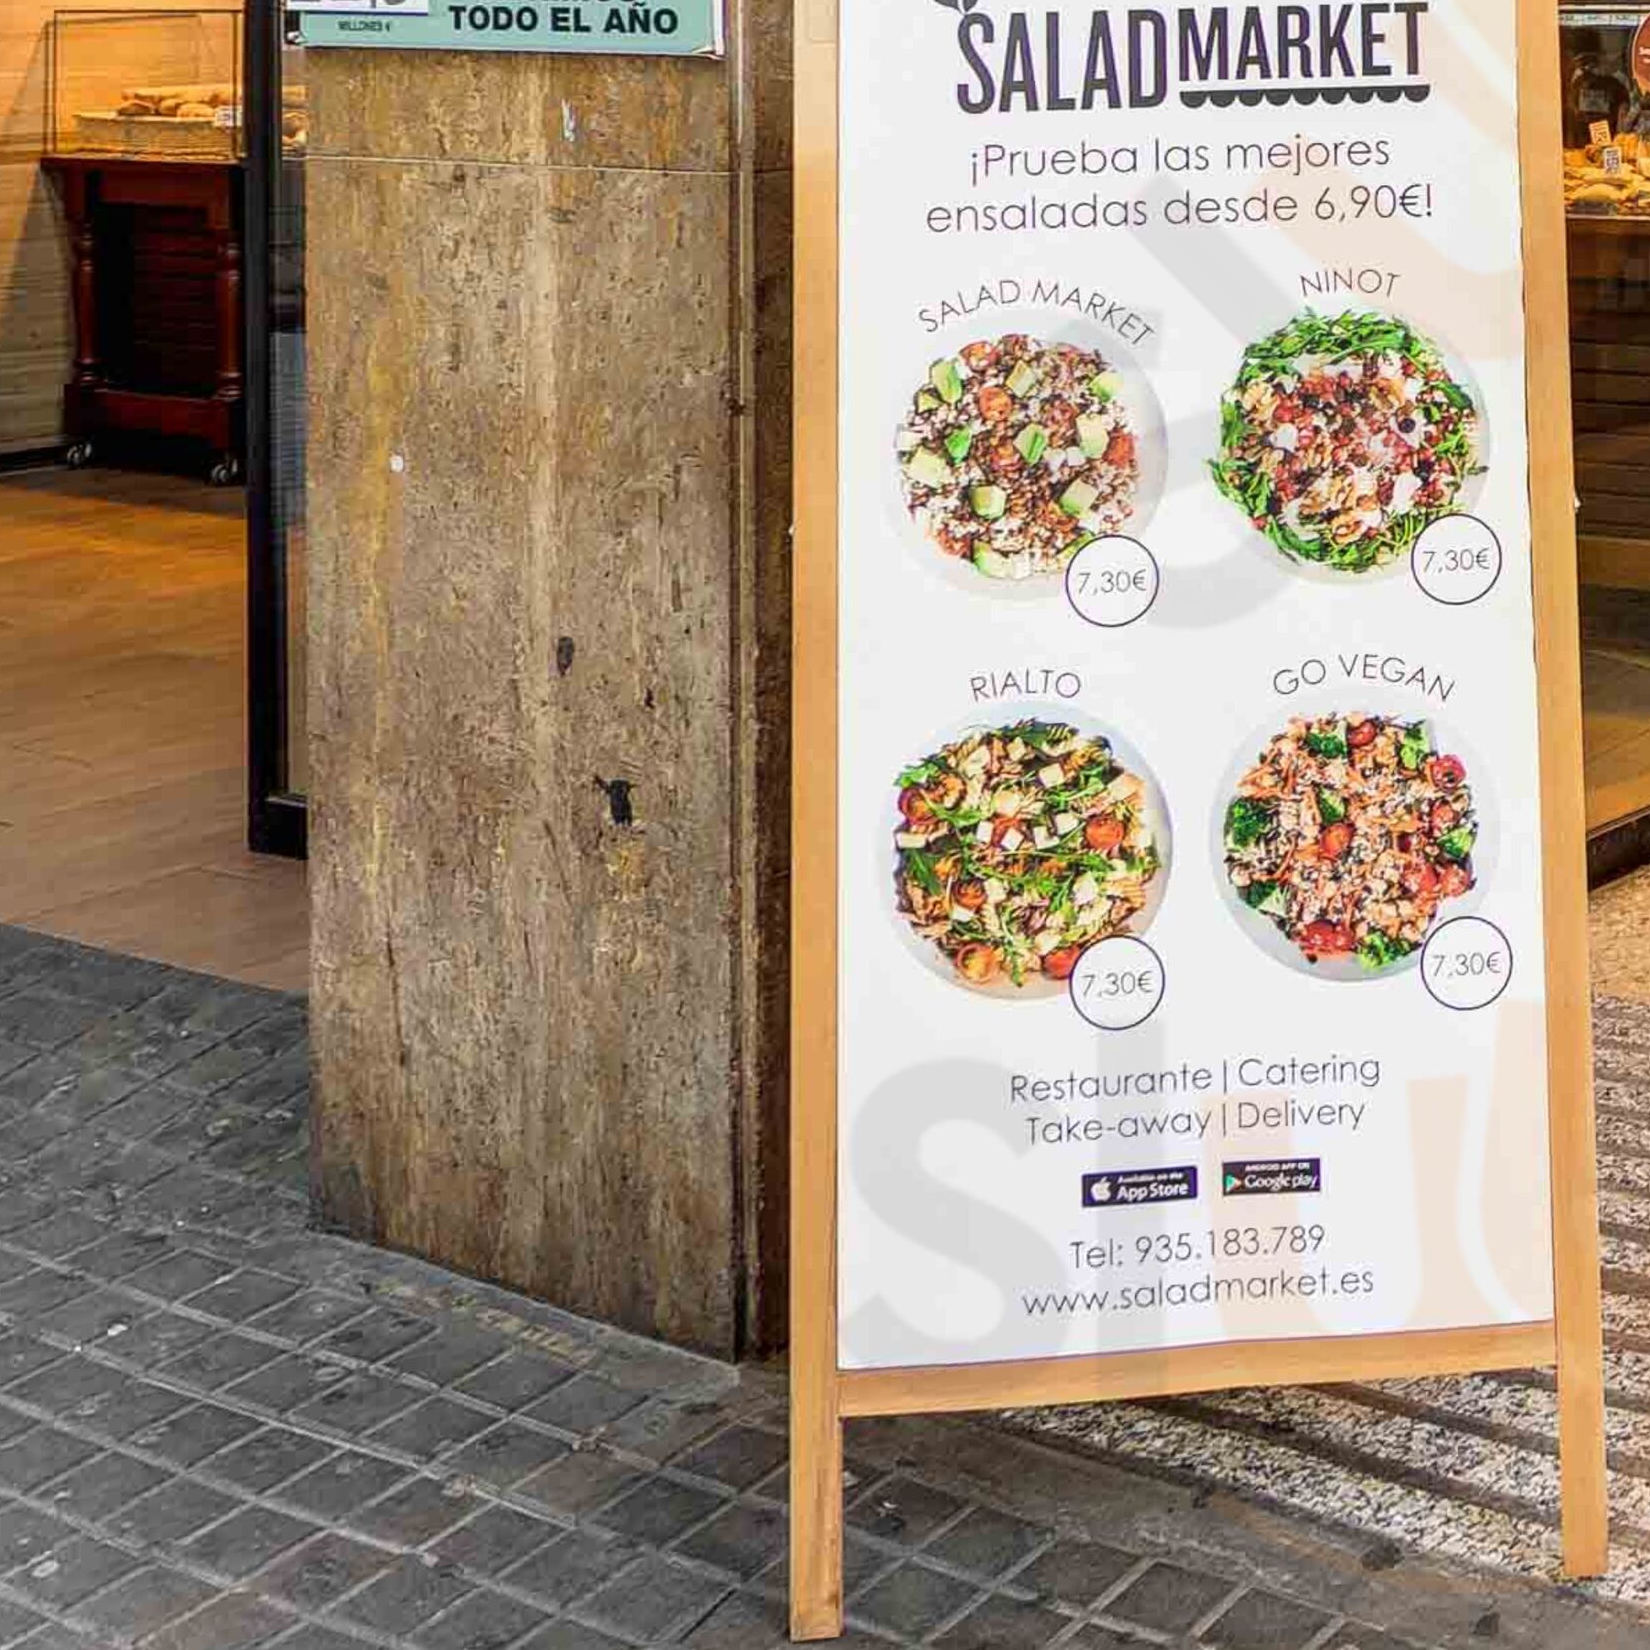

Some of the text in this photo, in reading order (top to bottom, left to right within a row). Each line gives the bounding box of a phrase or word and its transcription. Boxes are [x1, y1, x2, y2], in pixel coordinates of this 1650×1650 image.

[450, 2, 678, 34] TODO EL AÑO
[969, 132, 1391, 188] ¡Prueba las mejores
[926, 184, 1435, 235] ensaladas desde 6,90€!
[1299, 268, 1403, 299] NINOT
[917, 279, 1156, 349] SALAD MARKET
[1421, 545, 1493, 574] 7,30€
[1076, 566, 1149, 596] 7,30€
[970, 668, 1084, 703] RIALTO
[1272, 653, 1457, 702] GO VEGAN
[1431, 949, 1503, 979] 7,30€
[1081, 967, 1155, 998] 7,30€
[1010, 1052, 1383, 1104] Restaurante Catering
[1026, 1099, 1368, 1148] Take-away Delivery
[1117, 1180, 1189, 1202] App Store
[1245, 1172, 1318, 1192] Google play
[1070, 1225, 1326, 1272] Tel: 935.183.789
[1022, 1267, 1375, 1319] www.saladmarket.es
